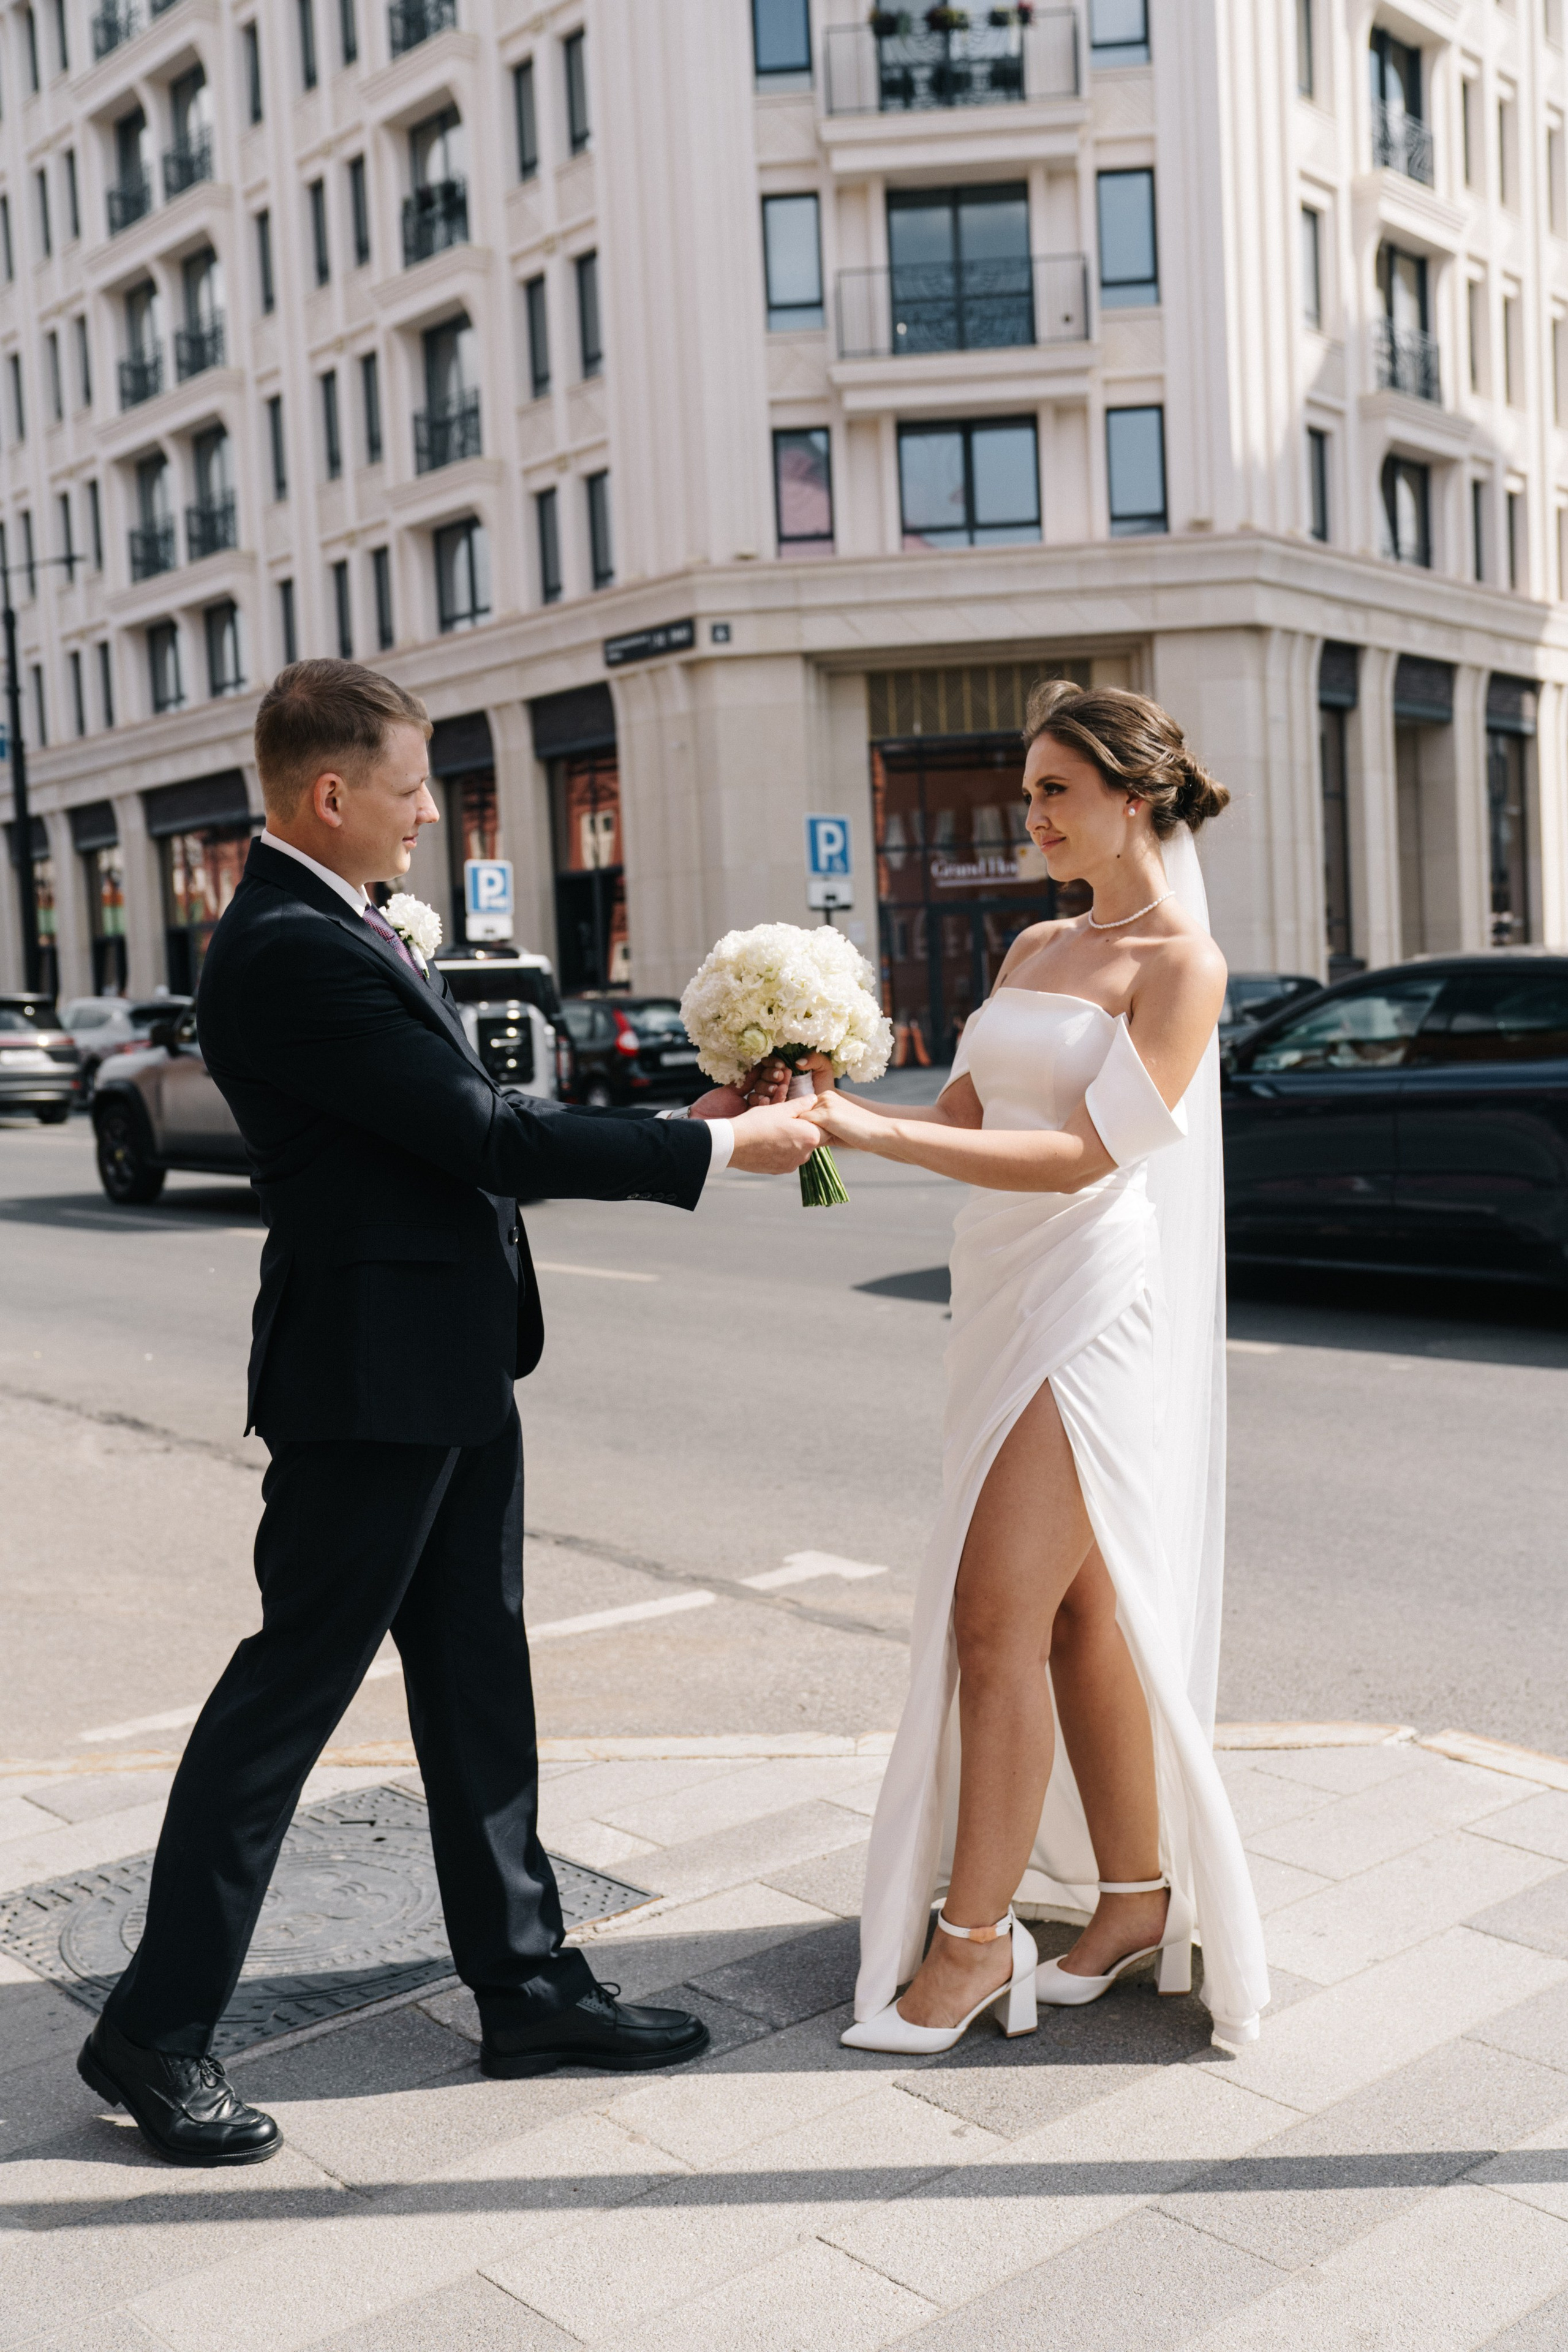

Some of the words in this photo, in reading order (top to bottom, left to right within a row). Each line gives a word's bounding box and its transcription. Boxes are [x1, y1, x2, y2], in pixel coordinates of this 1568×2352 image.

[816, 821, 845, 870] P
[478, 868, 505, 909] P
[930, 858, 986, 878] Grand
